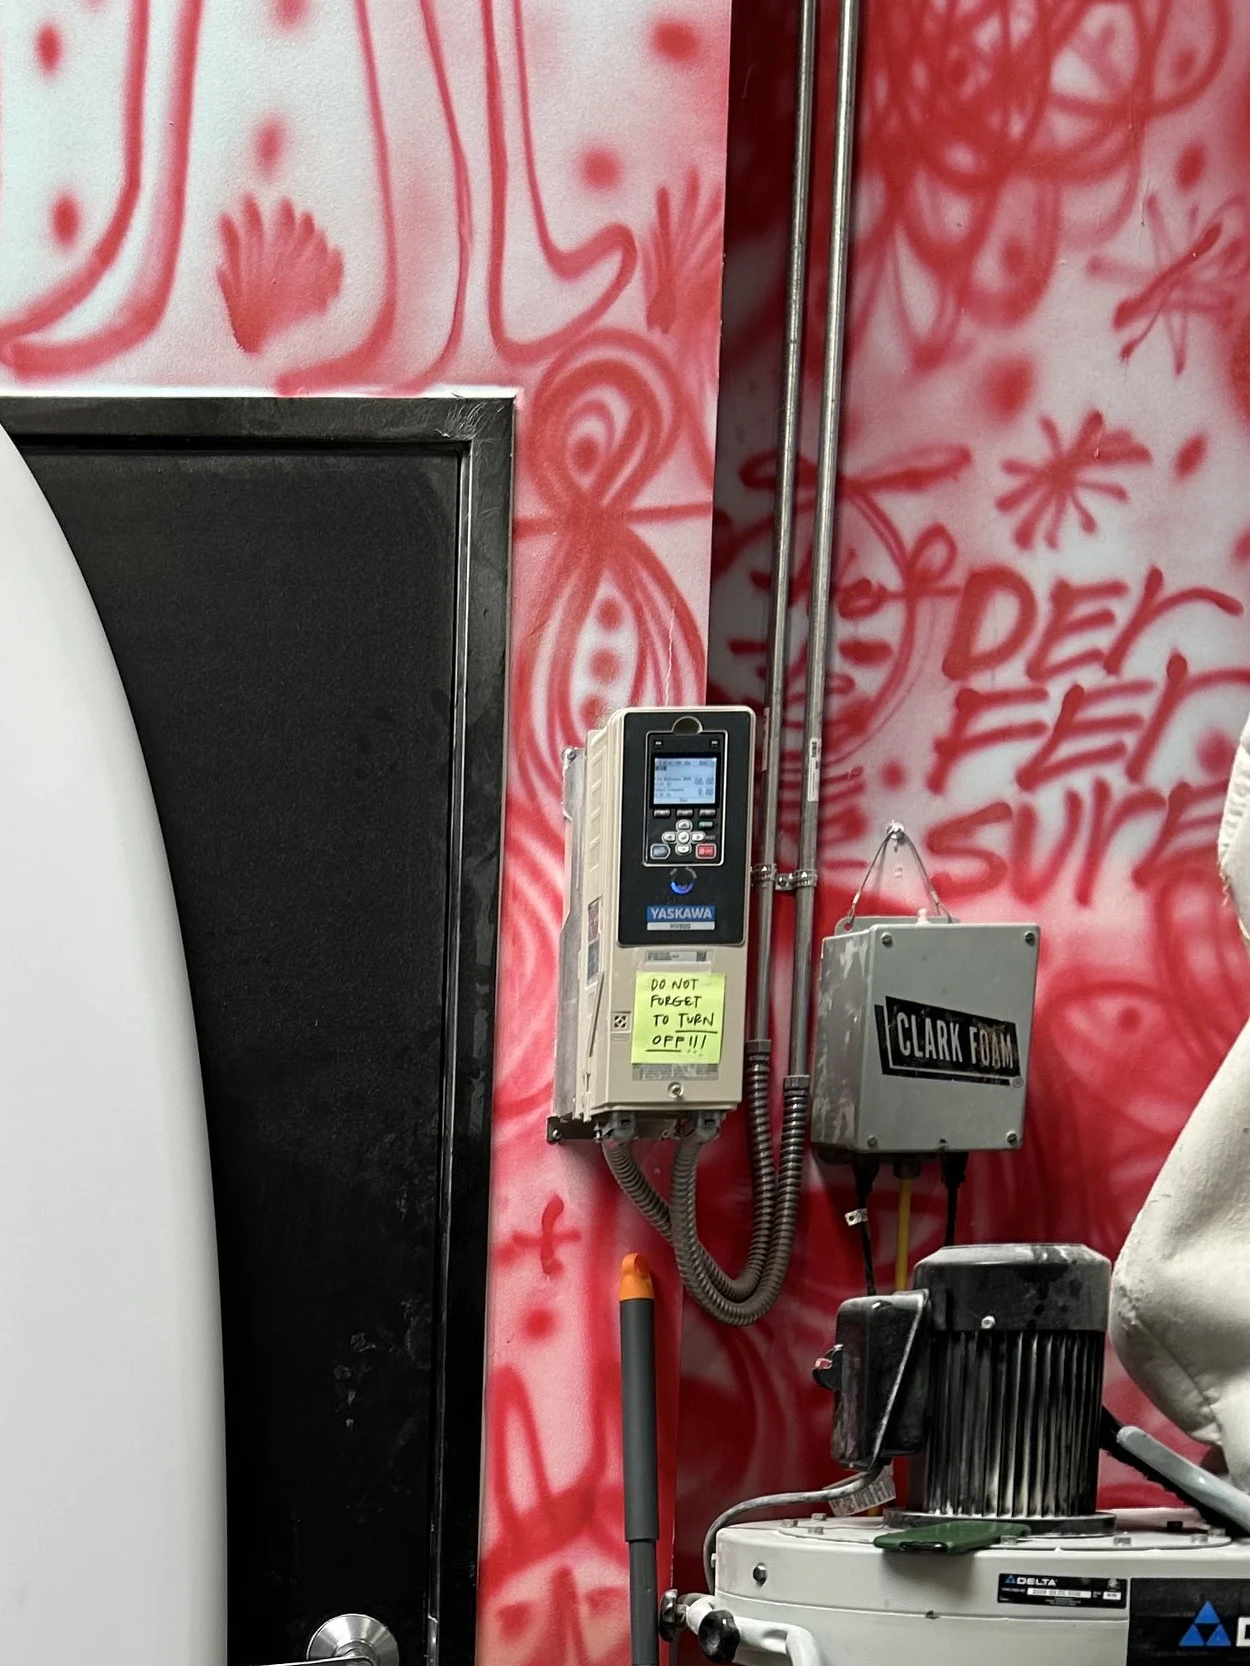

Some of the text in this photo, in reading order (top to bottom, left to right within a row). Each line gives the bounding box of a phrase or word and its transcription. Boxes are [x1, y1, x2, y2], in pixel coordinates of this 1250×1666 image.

[650, 907, 713, 919] YASKAWA
[651, 978, 699, 991] DO NOT
[650, 994, 702, 1008] FORGET
[653, 1012, 715, 1028] TO TURN
[897, 1011, 1014, 1069] CLARK FOAM
[1016, 1576, 1057, 1586] DELTA
